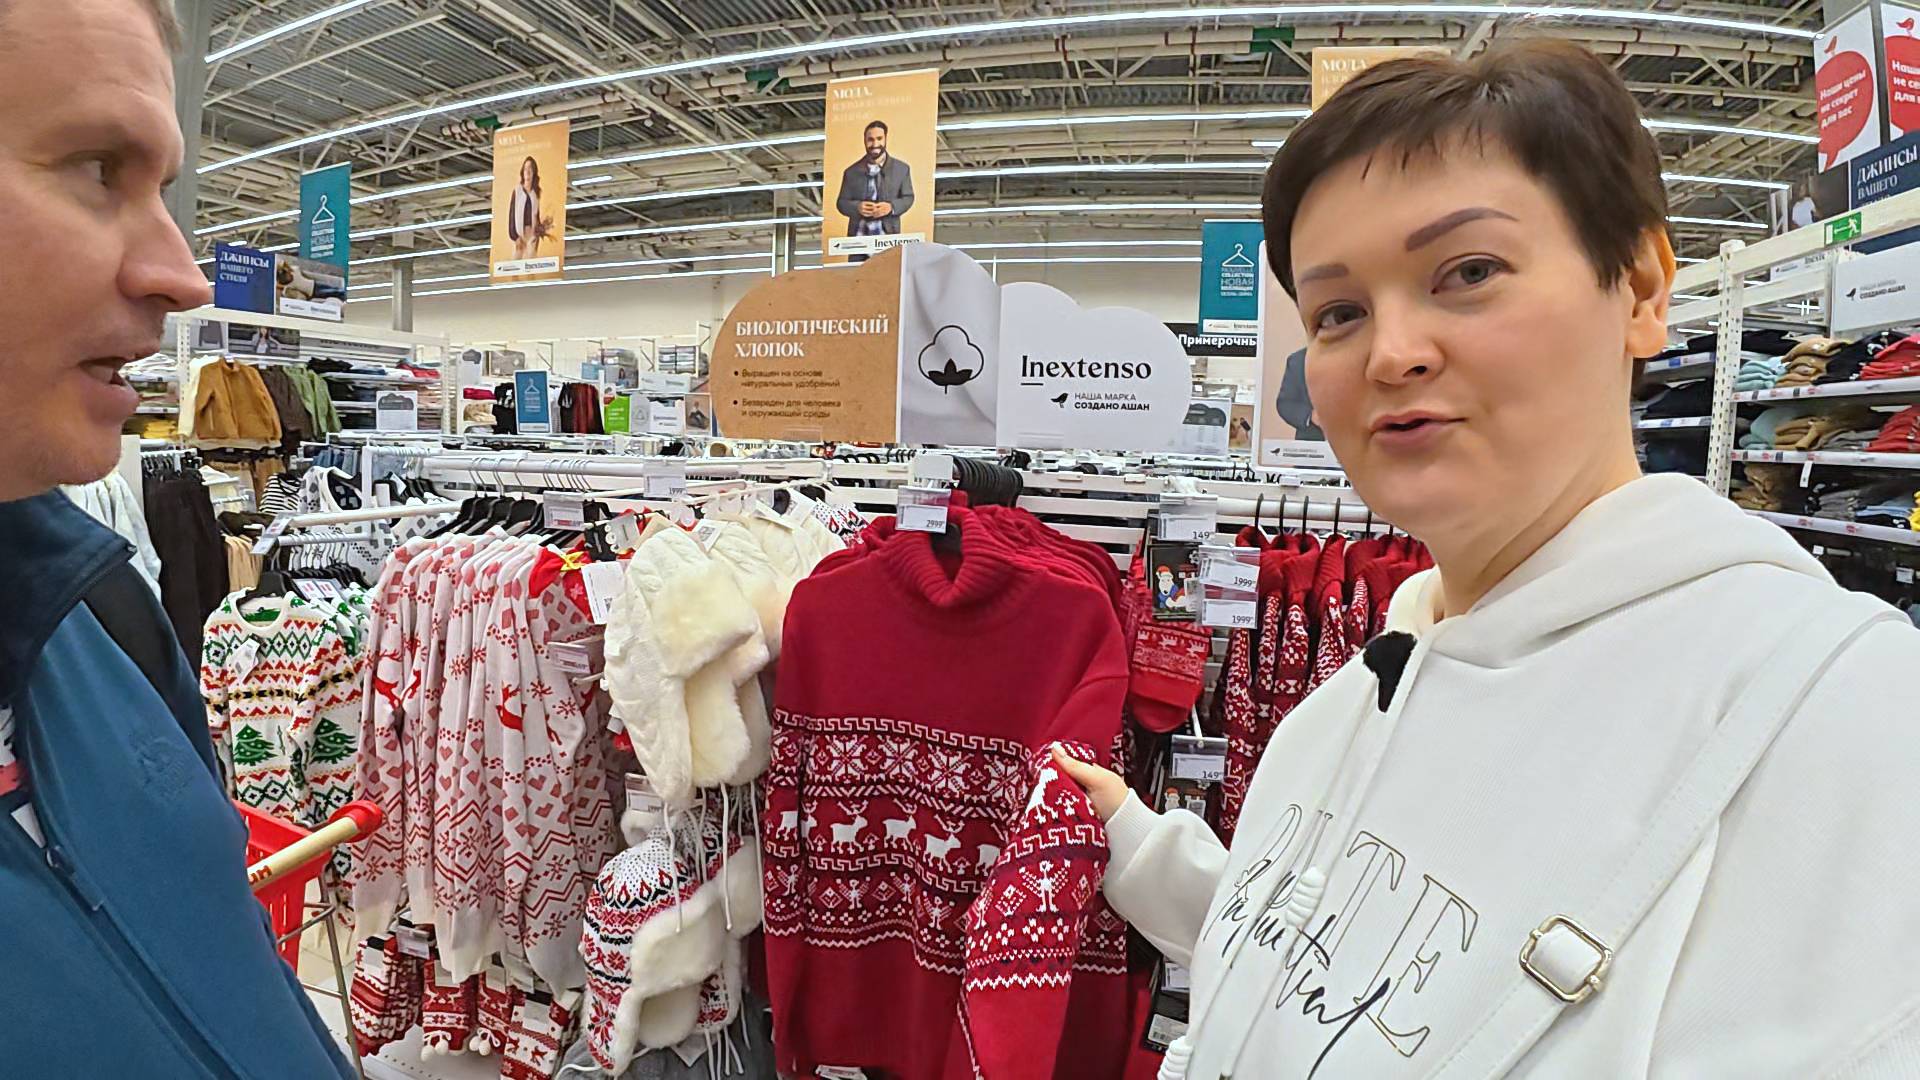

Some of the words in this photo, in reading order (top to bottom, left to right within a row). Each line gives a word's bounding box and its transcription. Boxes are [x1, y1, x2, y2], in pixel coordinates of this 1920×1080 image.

[1857, 144, 1918, 187] ДЖИНСЫ
[1857, 174, 1898, 200] ВАШЕГО
[735, 314, 889, 336] БИОЛОГИЧЕСКИЙ
[734, 341, 806, 358] ХЛОПОК
[1020, 355, 1152, 379] Inextenso
[1074, 393, 1102, 401] НАША
[1104, 393, 1137, 402] МАРКА
[786, 400, 802, 408] для
[1074, 401, 1119, 411] СОЗДАНО
[1120, 402, 1150, 411] АШАН
[1192, 530, 1210, 540] 149
[1233, 576, 1253, 588] 1999
[1232, 615, 1251, 624] 1999
[1202, 770, 1219, 780] 149
